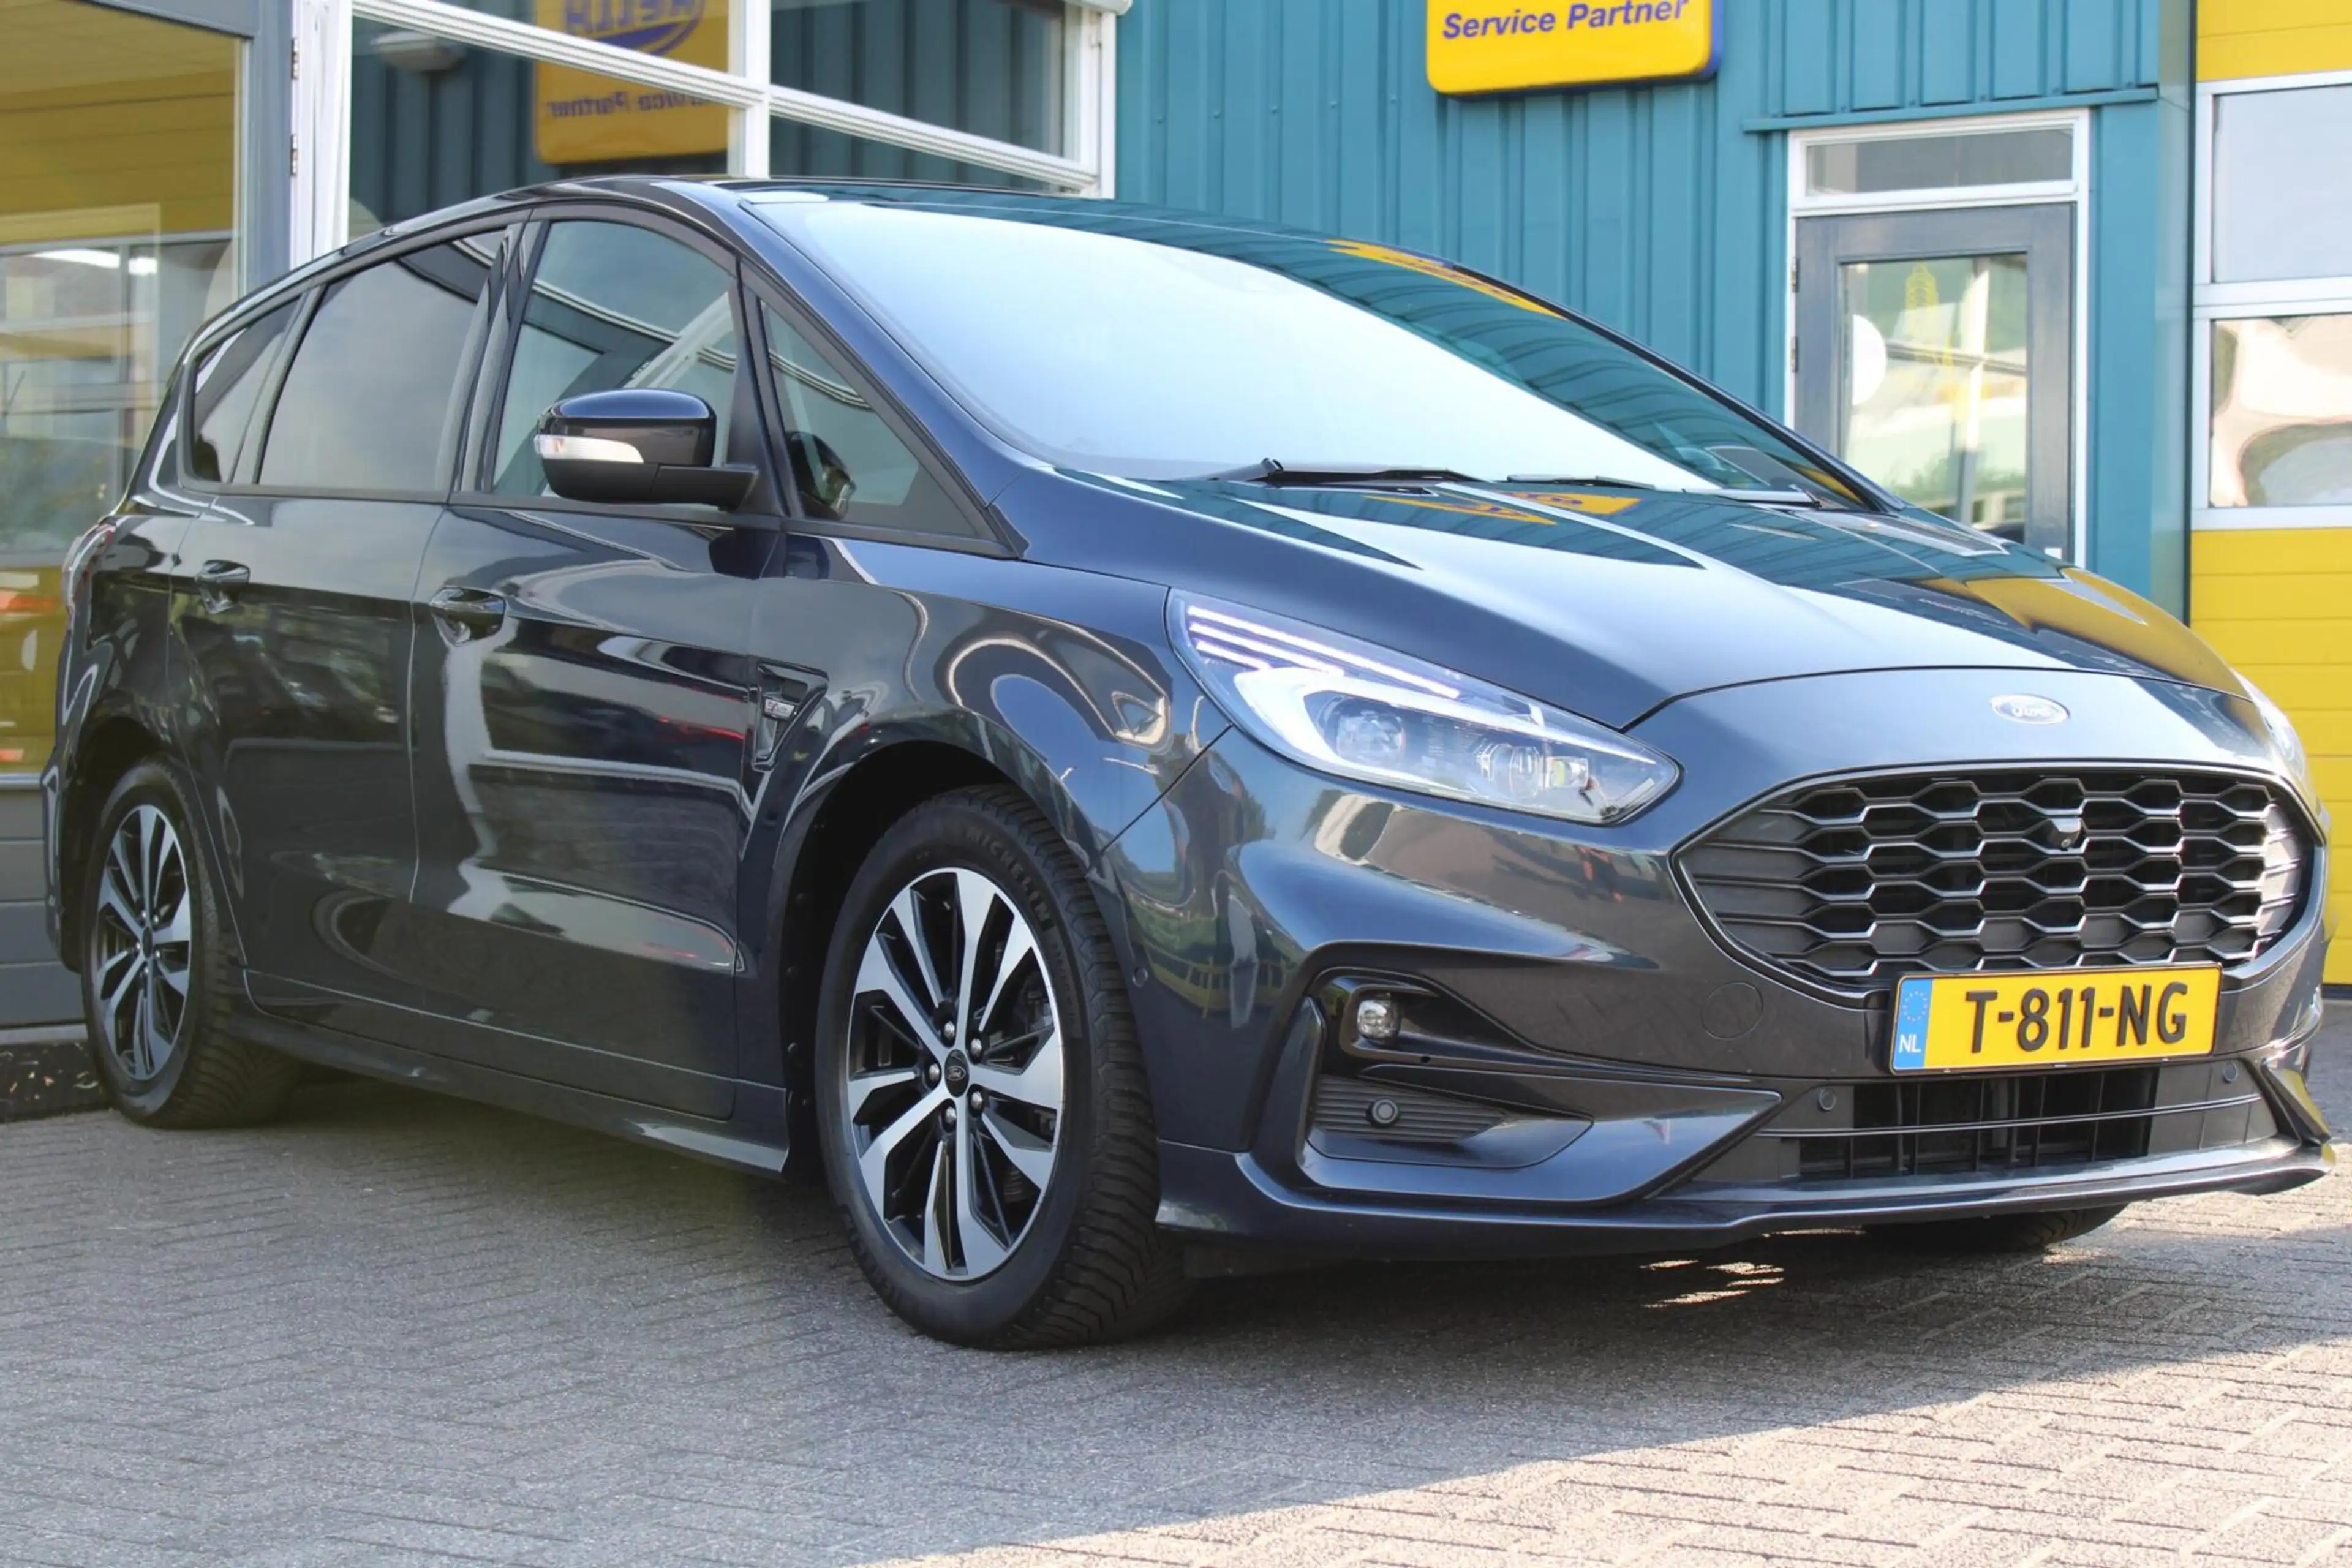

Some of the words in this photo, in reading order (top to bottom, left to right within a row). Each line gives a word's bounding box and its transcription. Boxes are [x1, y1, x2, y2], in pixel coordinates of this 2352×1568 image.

[1442, 9, 1556, 39] Service
[1567, 0, 1689, 29] Partner
[967, 827, 1052, 922] MICHELIN
[1898, 1034, 1922, 1054] NL
[1965, 981, 2188, 1054] T-811-NG
